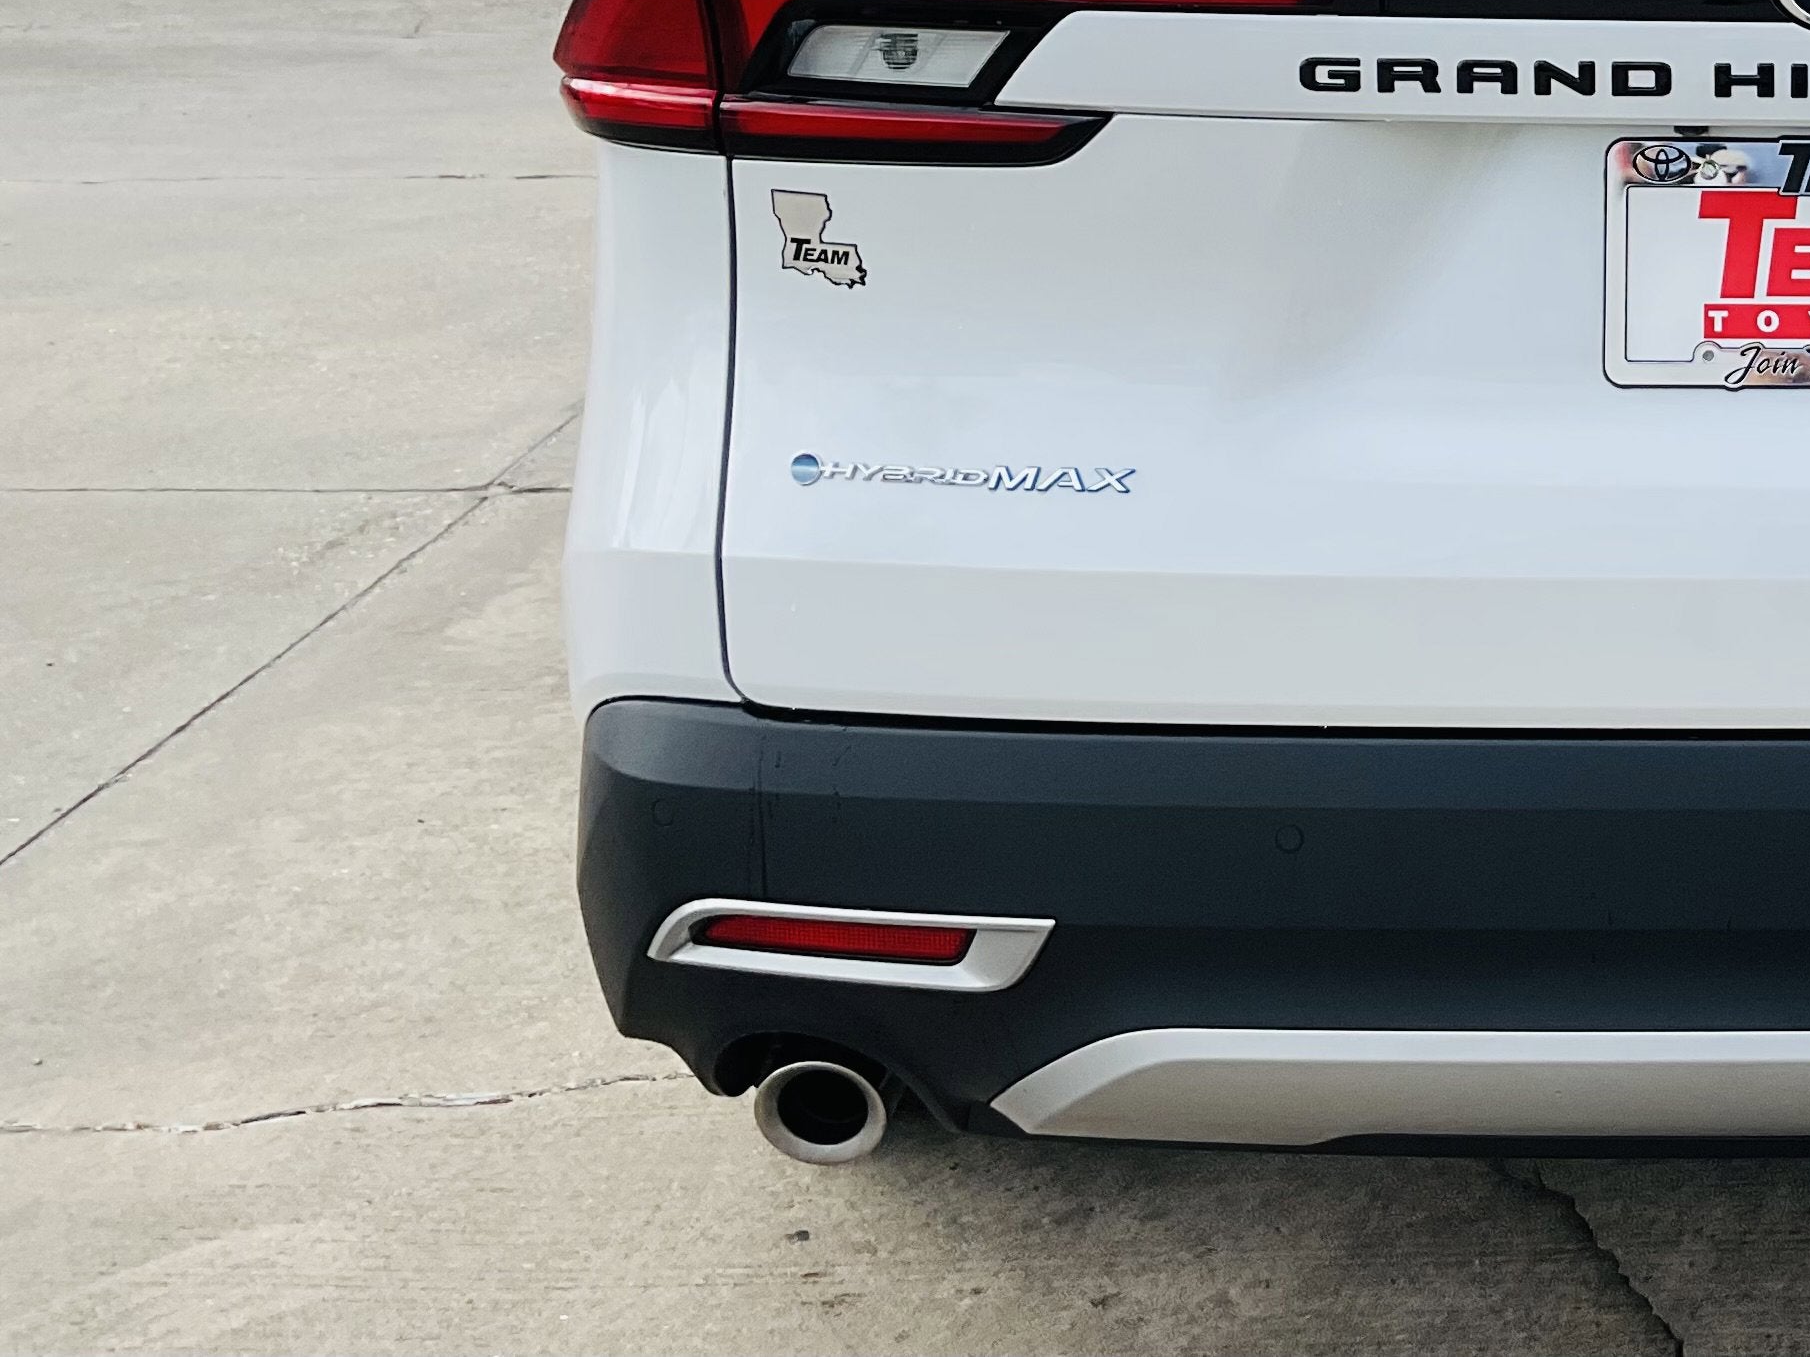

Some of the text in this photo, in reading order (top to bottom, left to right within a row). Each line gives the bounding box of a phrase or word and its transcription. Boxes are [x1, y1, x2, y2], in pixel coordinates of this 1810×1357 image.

[1299, 57, 1673, 97] GRAND
[790, 237, 850, 265] TEAM
[1725, 345, 1800, 384] Join
